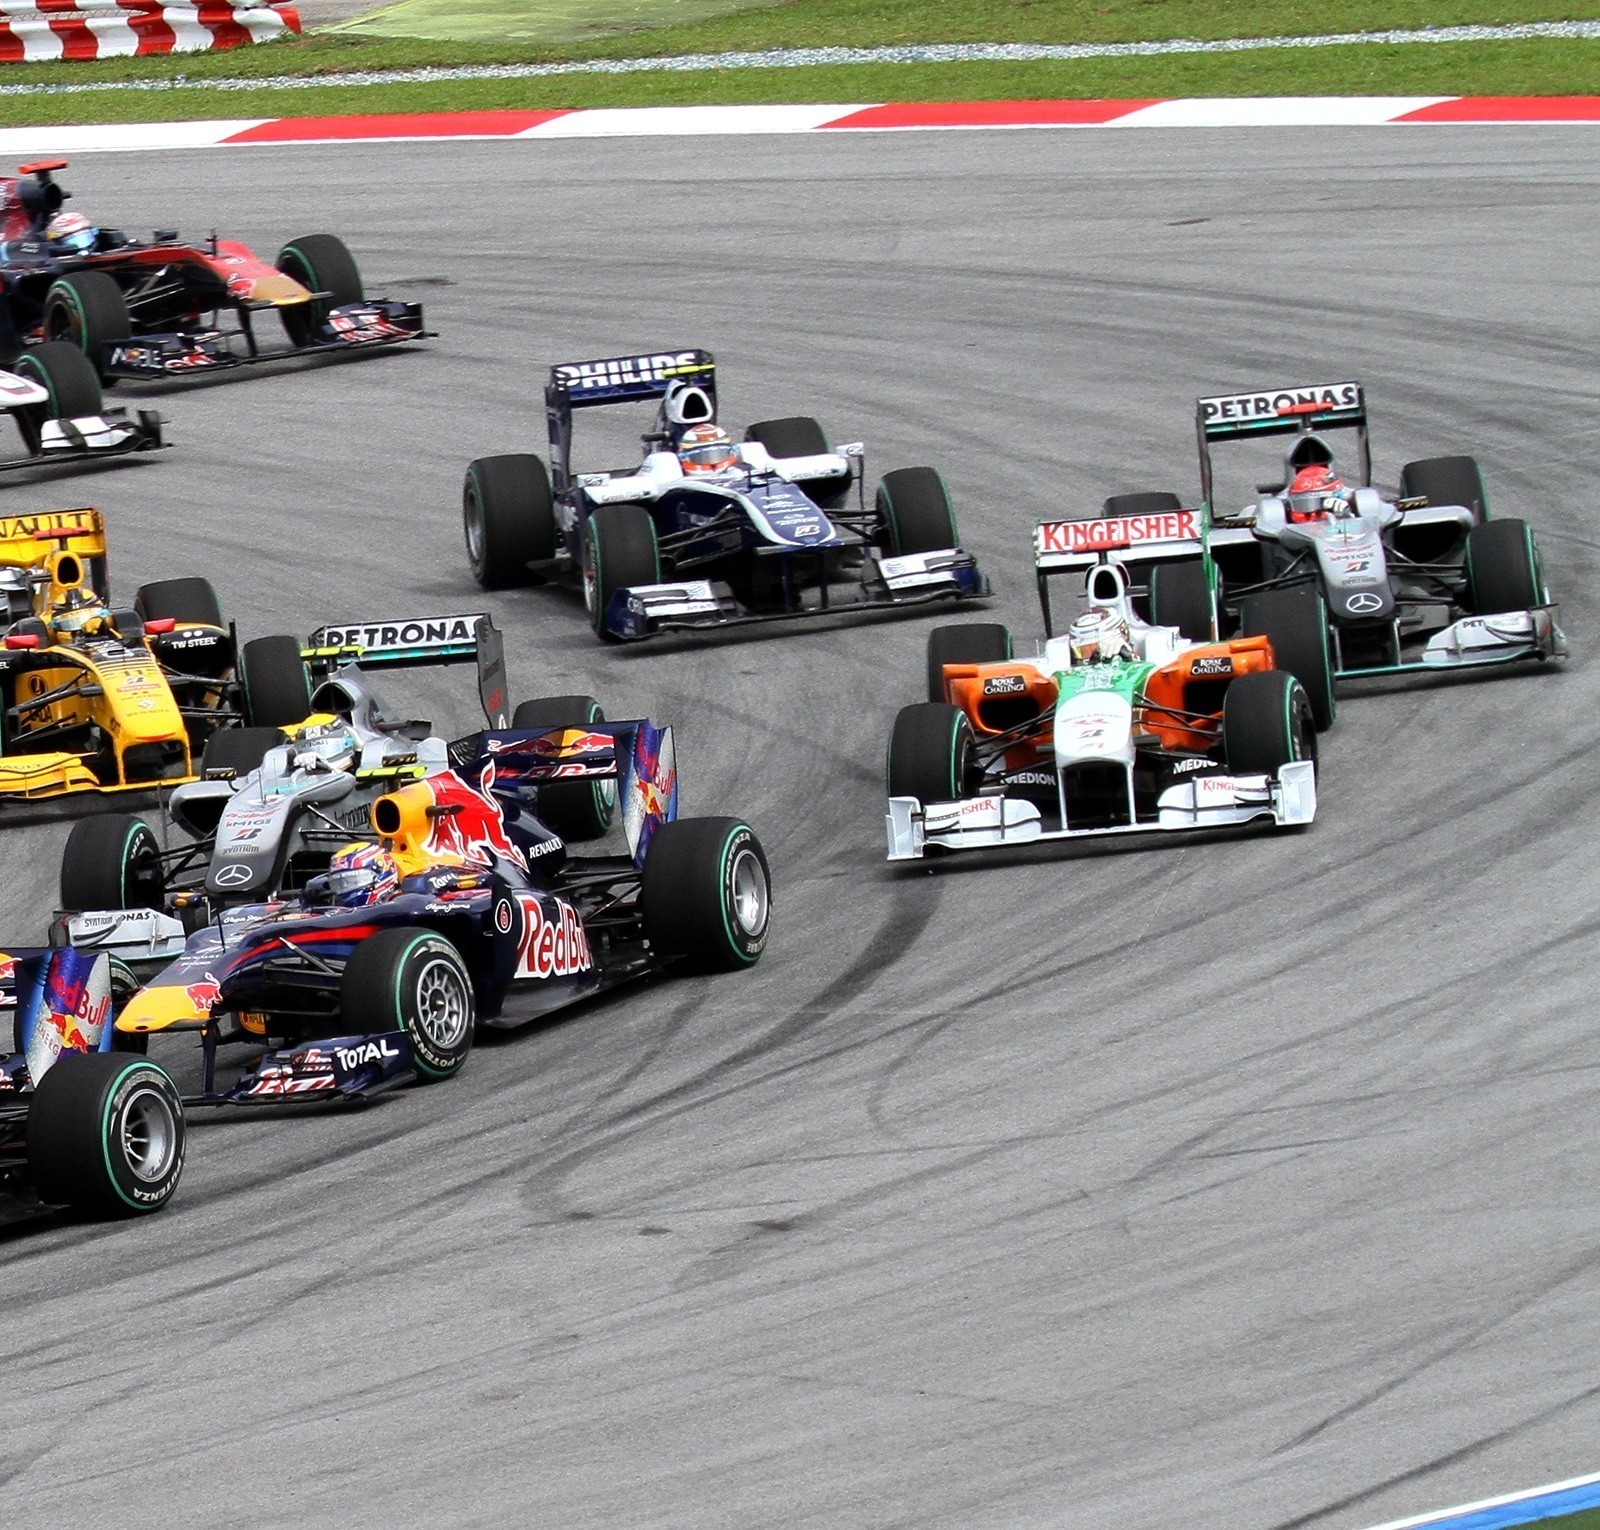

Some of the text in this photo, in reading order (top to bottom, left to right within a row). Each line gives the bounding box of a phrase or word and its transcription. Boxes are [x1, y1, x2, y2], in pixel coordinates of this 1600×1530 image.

[557, 353, 696, 389] PHILIPS
[1201, 387, 1355, 420] PETRONAS
[1043, 511, 1201, 555] KINGFISHER
[326, 620, 478, 648] PETRONA
[1463, 619, 1485, 629] PET
[188, 637, 217, 648] STEEL
[1000, 772, 1057, 786] MEDION
[961, 799, 997, 816] ISHER
[529, 837, 563, 859] RENAULT
[76, 989, 112, 1027] Bull
[335, 1039, 400, 1072] TOTAL
